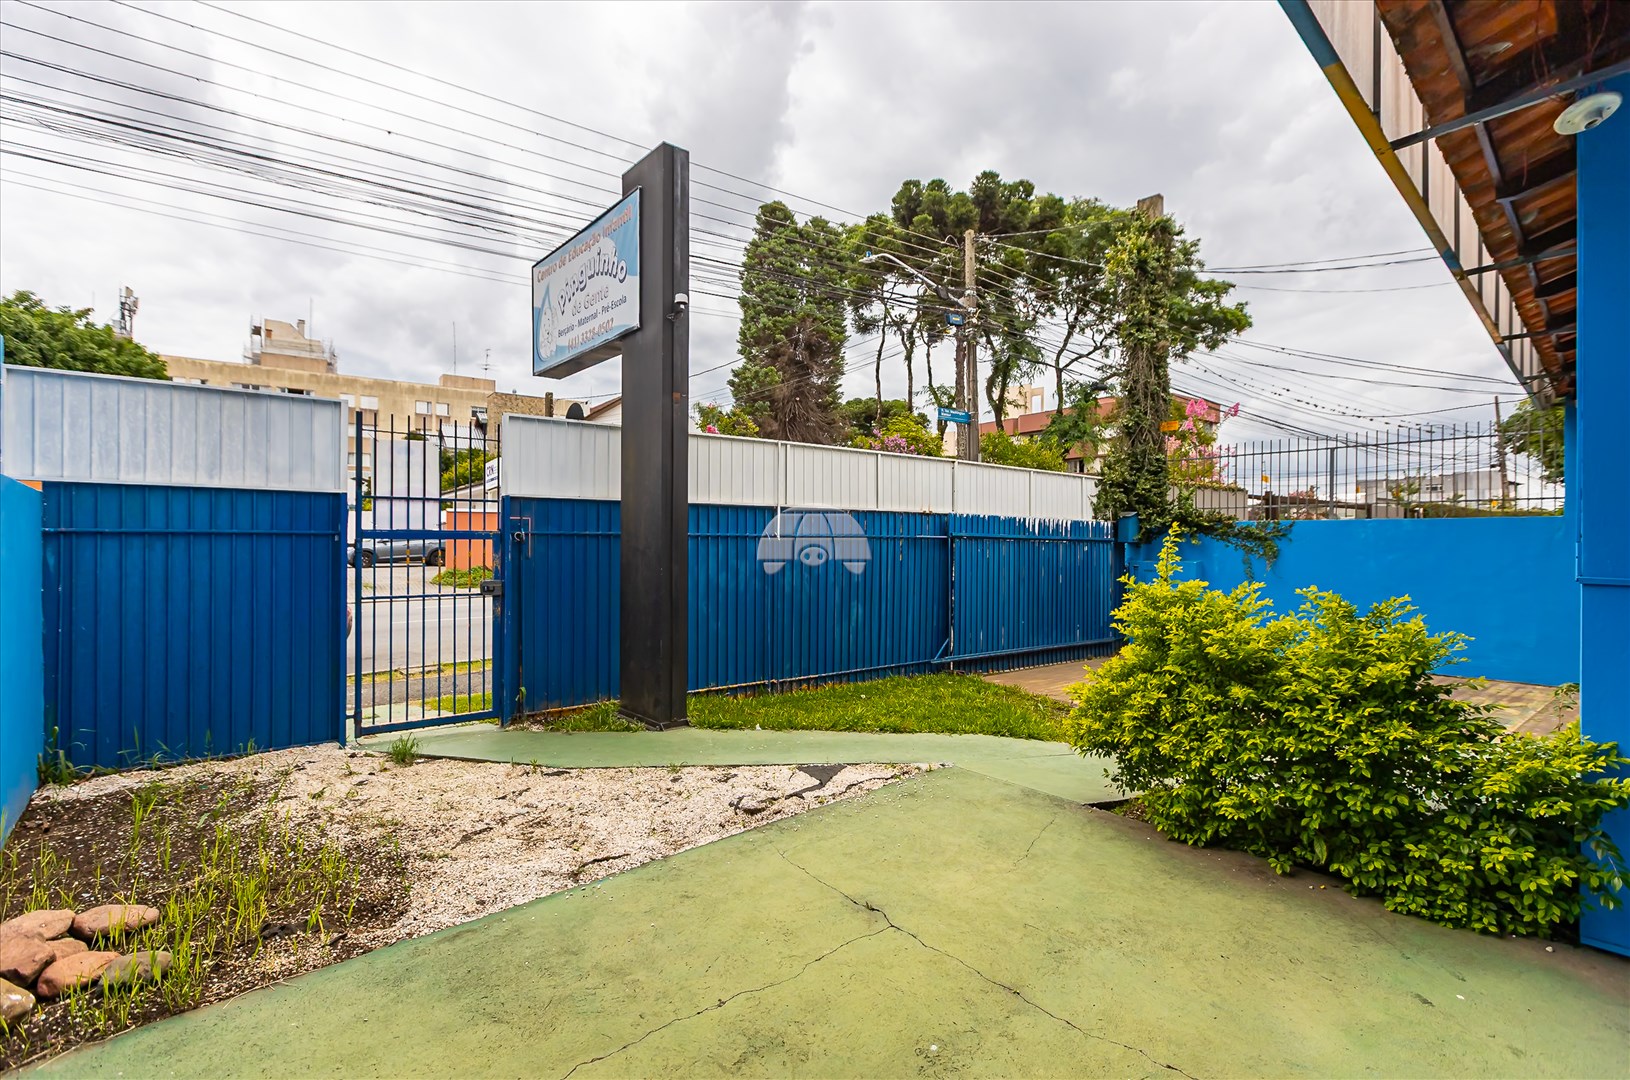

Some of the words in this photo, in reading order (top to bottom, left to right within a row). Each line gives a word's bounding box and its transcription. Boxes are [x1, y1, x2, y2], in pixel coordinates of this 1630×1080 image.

[538, 261, 557, 283] Centro
[558, 255, 567, 270] de
[568, 231, 601, 263] Educação
[602, 205, 632, 238] Infantil
[557, 246, 628, 316] Pinguinho
[571, 299, 582, 317] de
[583, 286, 609, 310] Gente
[577, 309, 598, 328] Maternal
[601, 294, 627, 316] Pré-Escola
